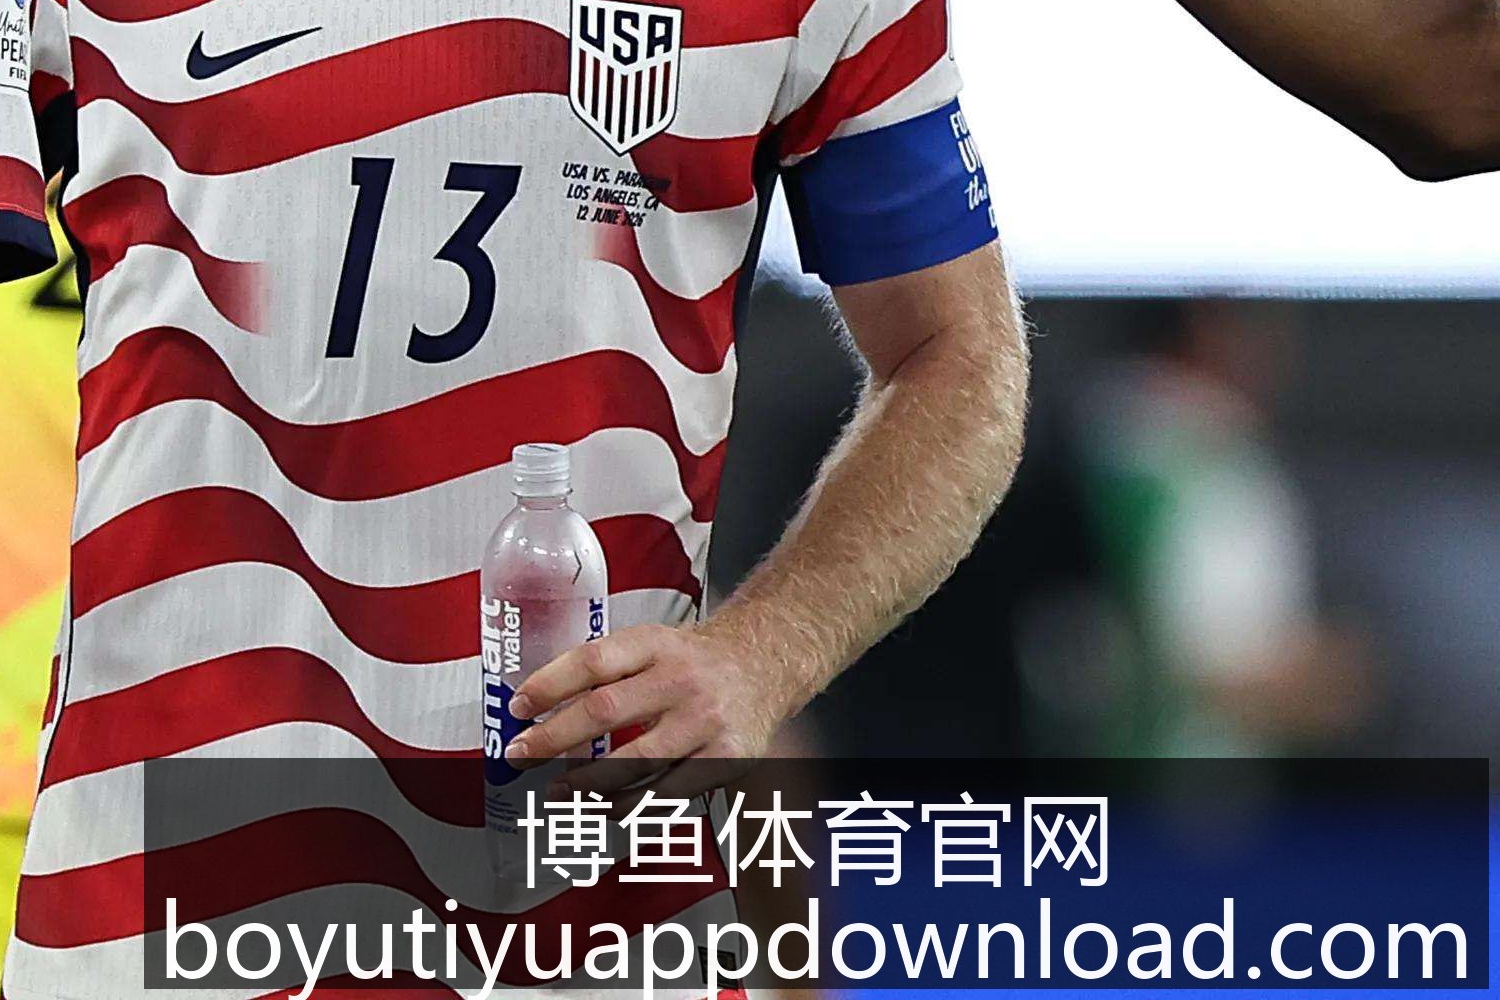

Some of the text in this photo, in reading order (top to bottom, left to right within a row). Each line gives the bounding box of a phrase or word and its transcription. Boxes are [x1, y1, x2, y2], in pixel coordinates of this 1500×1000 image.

[580, 5, 673, 66] USA
[562, 162, 588, 180] USA
[566, 183, 660, 211] LOS ANGELES, CA
[576, 204, 589, 220] 12
[591, 208, 620, 225] JUNE
[325, 156, 523, 364] 13
[502, 600, 522, 674] water
